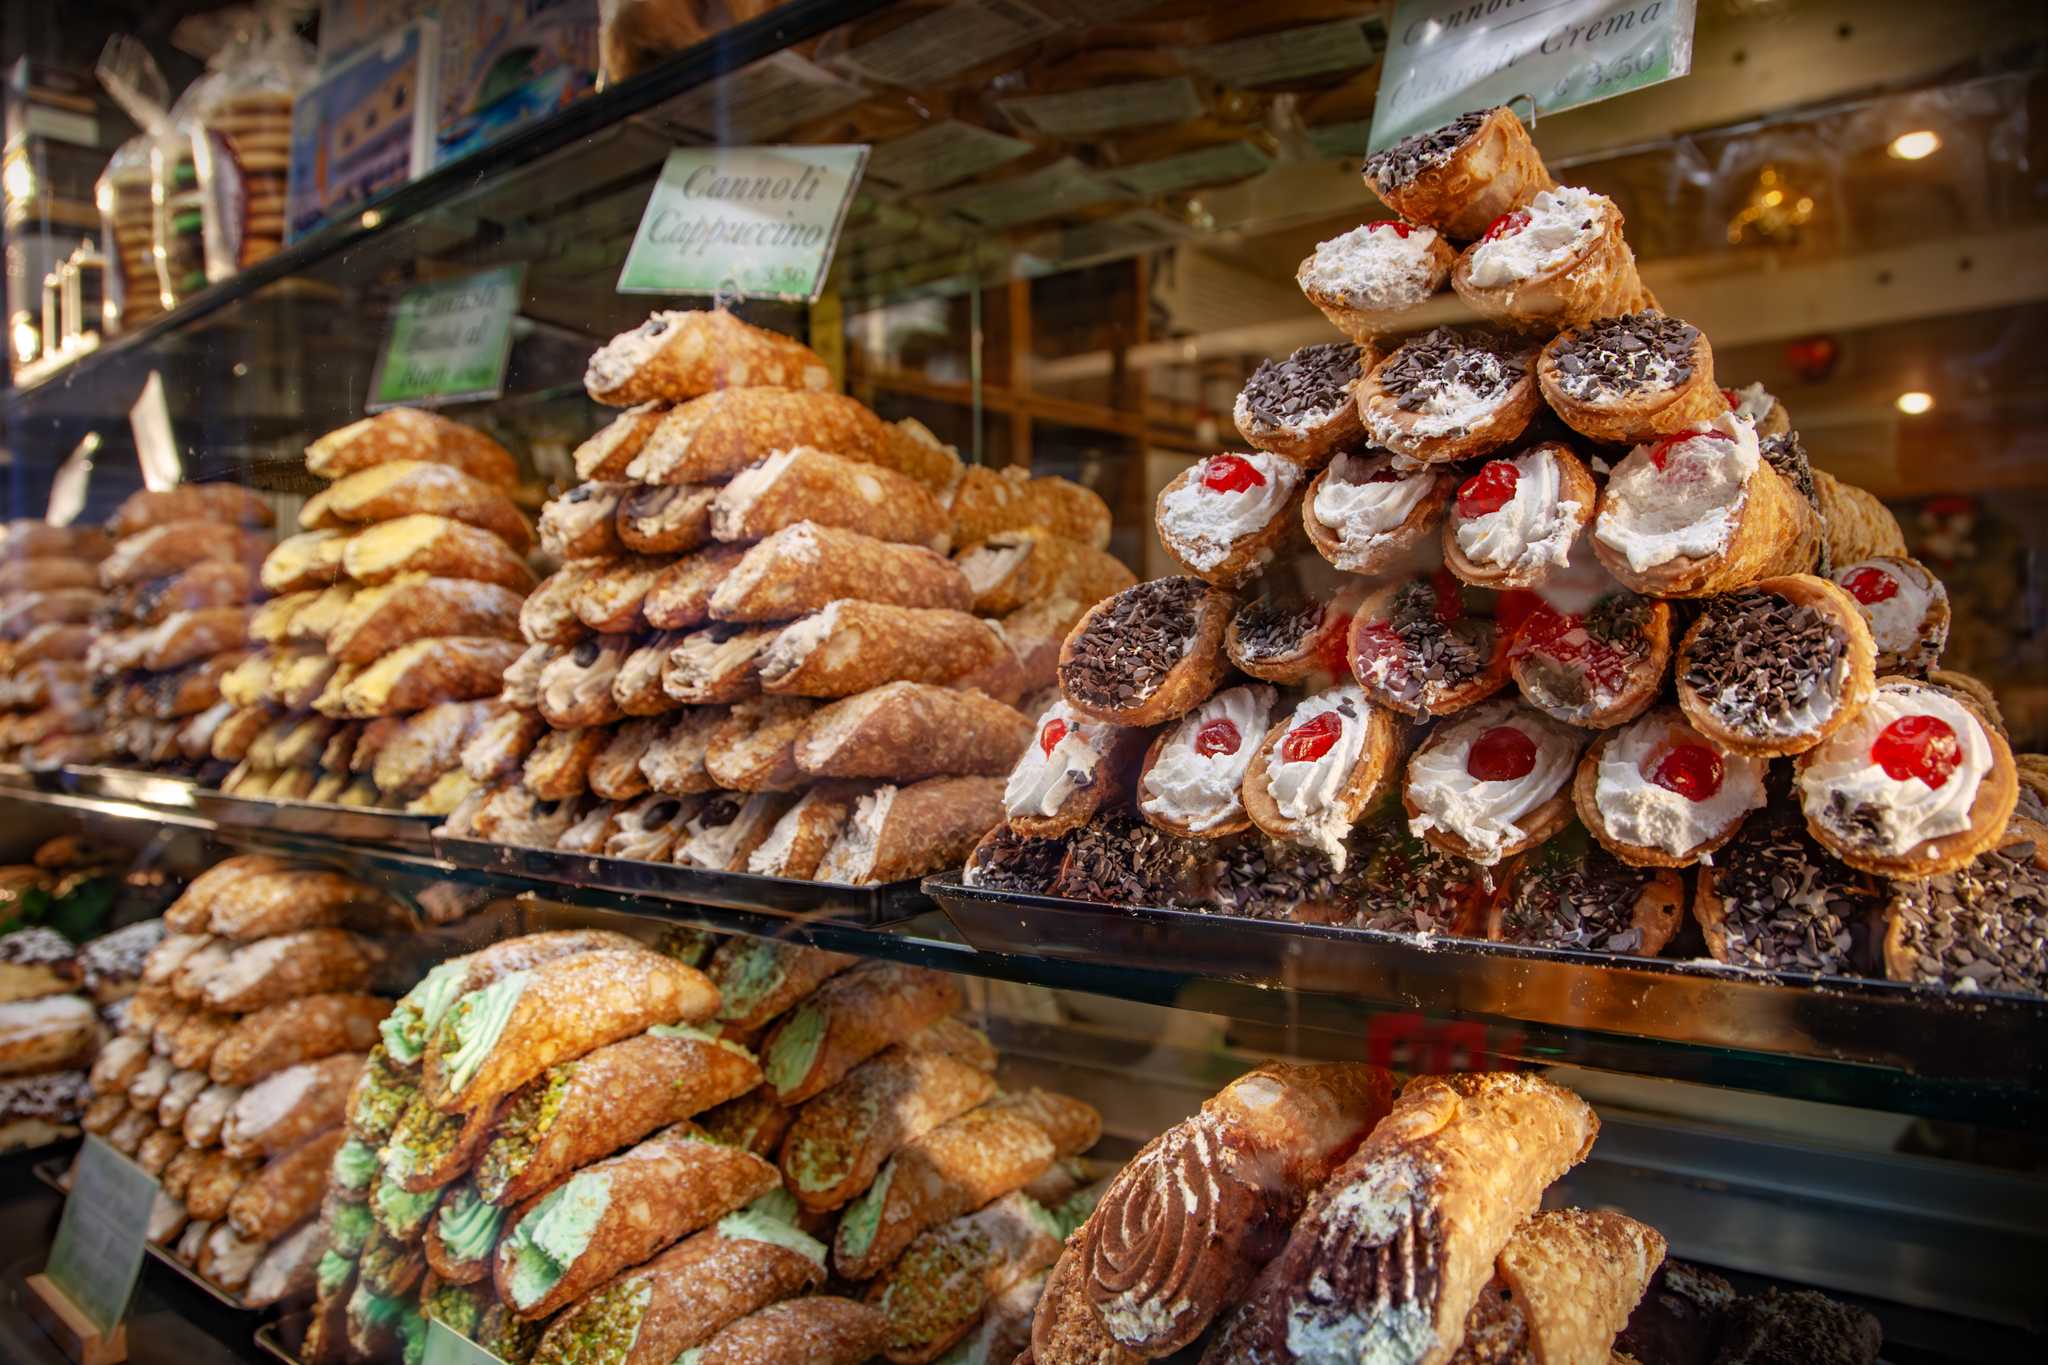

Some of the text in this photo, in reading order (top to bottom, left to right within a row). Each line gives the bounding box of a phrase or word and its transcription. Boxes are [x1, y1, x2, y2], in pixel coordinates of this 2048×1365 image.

[1540, 1, 1663, 55] Crema
[682, 163, 827, 201] Cannoli
[648, 207, 825, 256] Cappuccino
